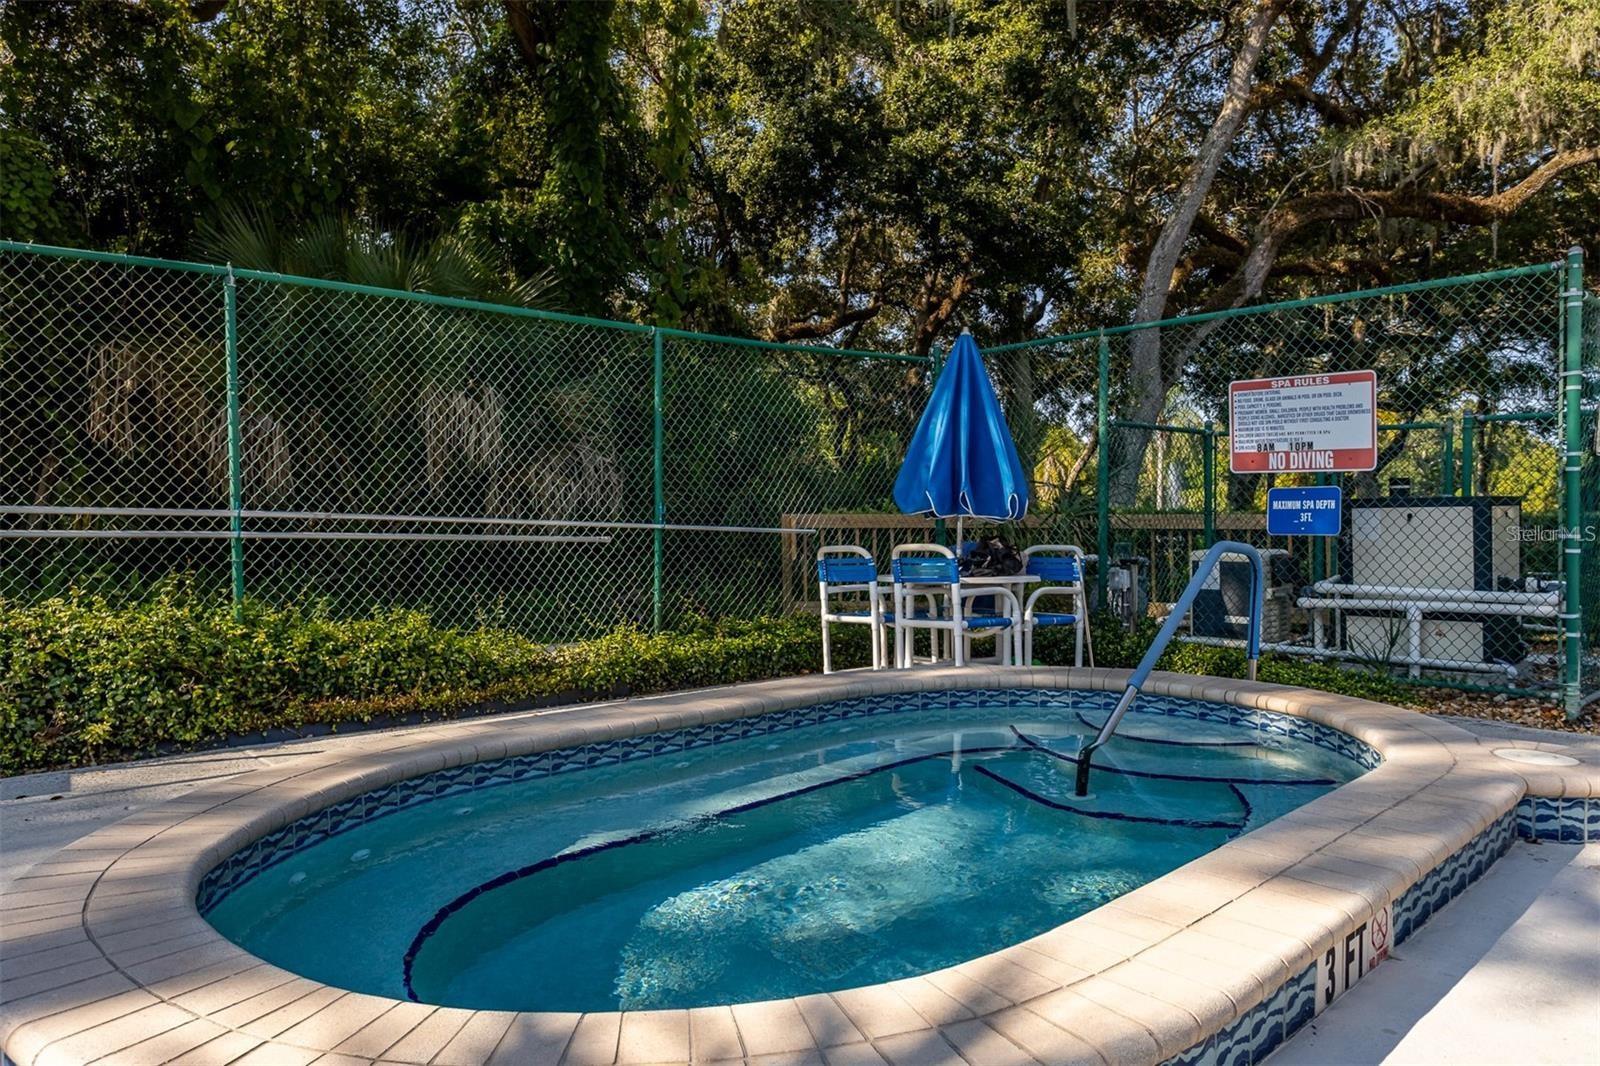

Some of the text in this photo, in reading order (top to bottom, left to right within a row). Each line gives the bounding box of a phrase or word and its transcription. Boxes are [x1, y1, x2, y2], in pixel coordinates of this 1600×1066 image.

[1271, 377, 1330, 388] SPA RULES
[1257, 443, 1275, 452] 8AM
[1289, 441, 1314, 451] 10PM
[1268, 450, 1334, 469] NO DIVING
[1272, 499, 1336, 510] MAXIMUM SPA DEPTH
[1325, 946, 1336, 1005] 3
[1344, 921, 1368, 991] FT
